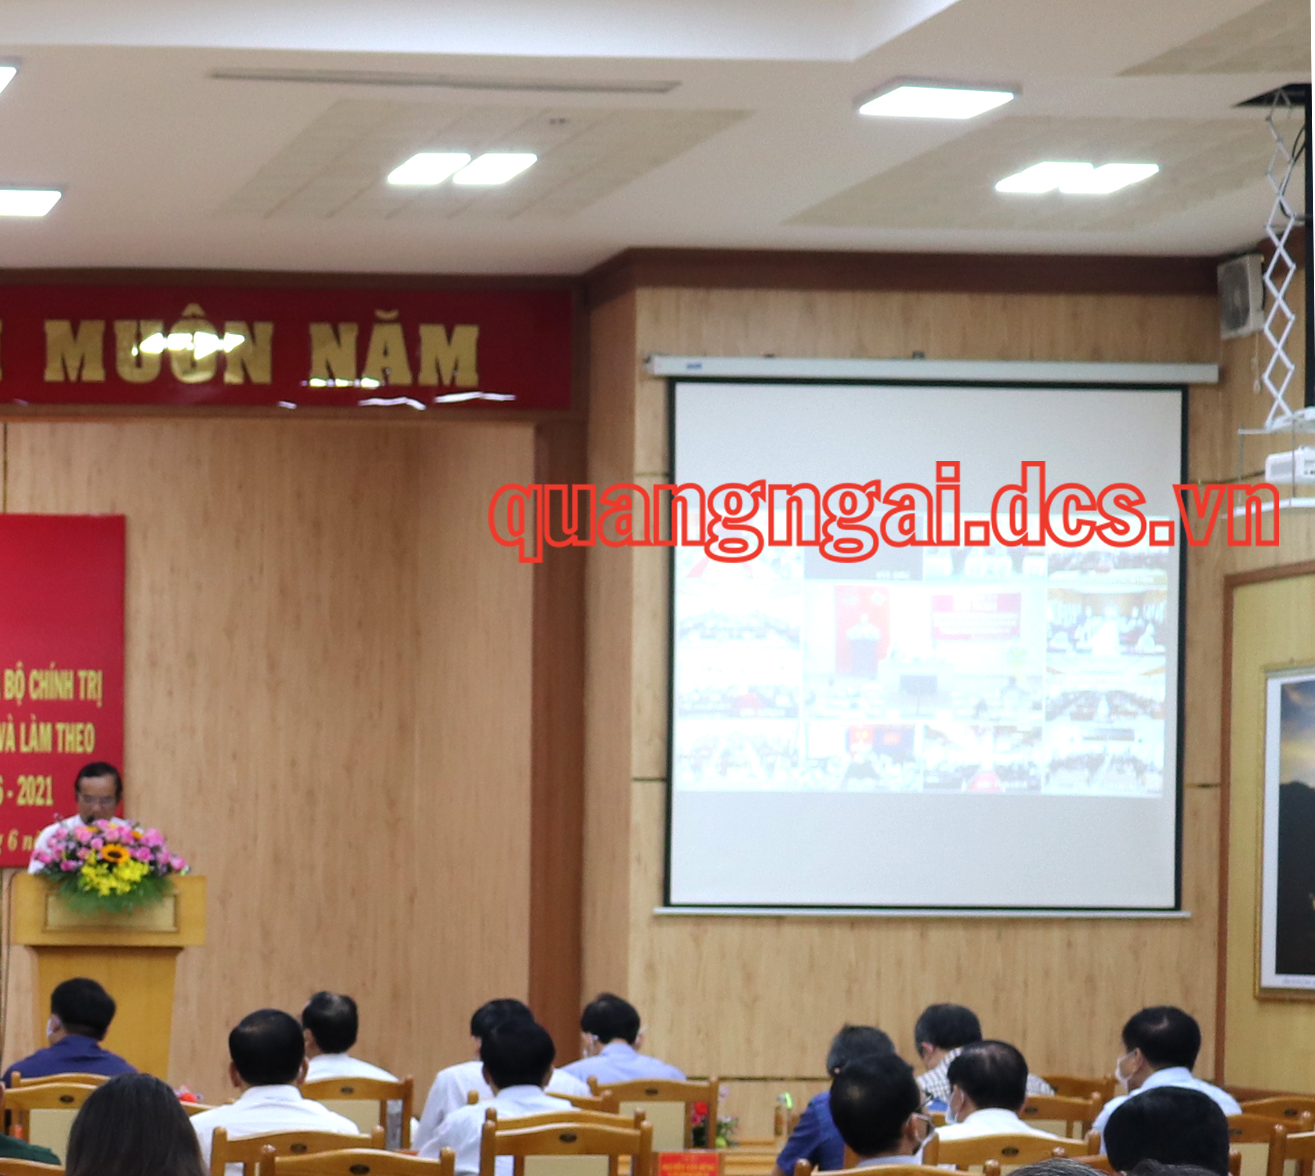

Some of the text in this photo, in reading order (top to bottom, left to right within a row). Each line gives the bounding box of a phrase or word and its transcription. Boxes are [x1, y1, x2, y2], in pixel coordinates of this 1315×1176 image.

[43, 303, 274, 384] MUÔN
[309, 309, 480, 387] NĂM
[29, 662, 73, 699] CHÍNH
[78, 670, 102, 706] TRỊ
[20, 714, 52, 752] LÀM
[56, 723, 94, 753] THEO
[18, 776, 54, 805] 2021
[8, 831, 17, 849] 6
